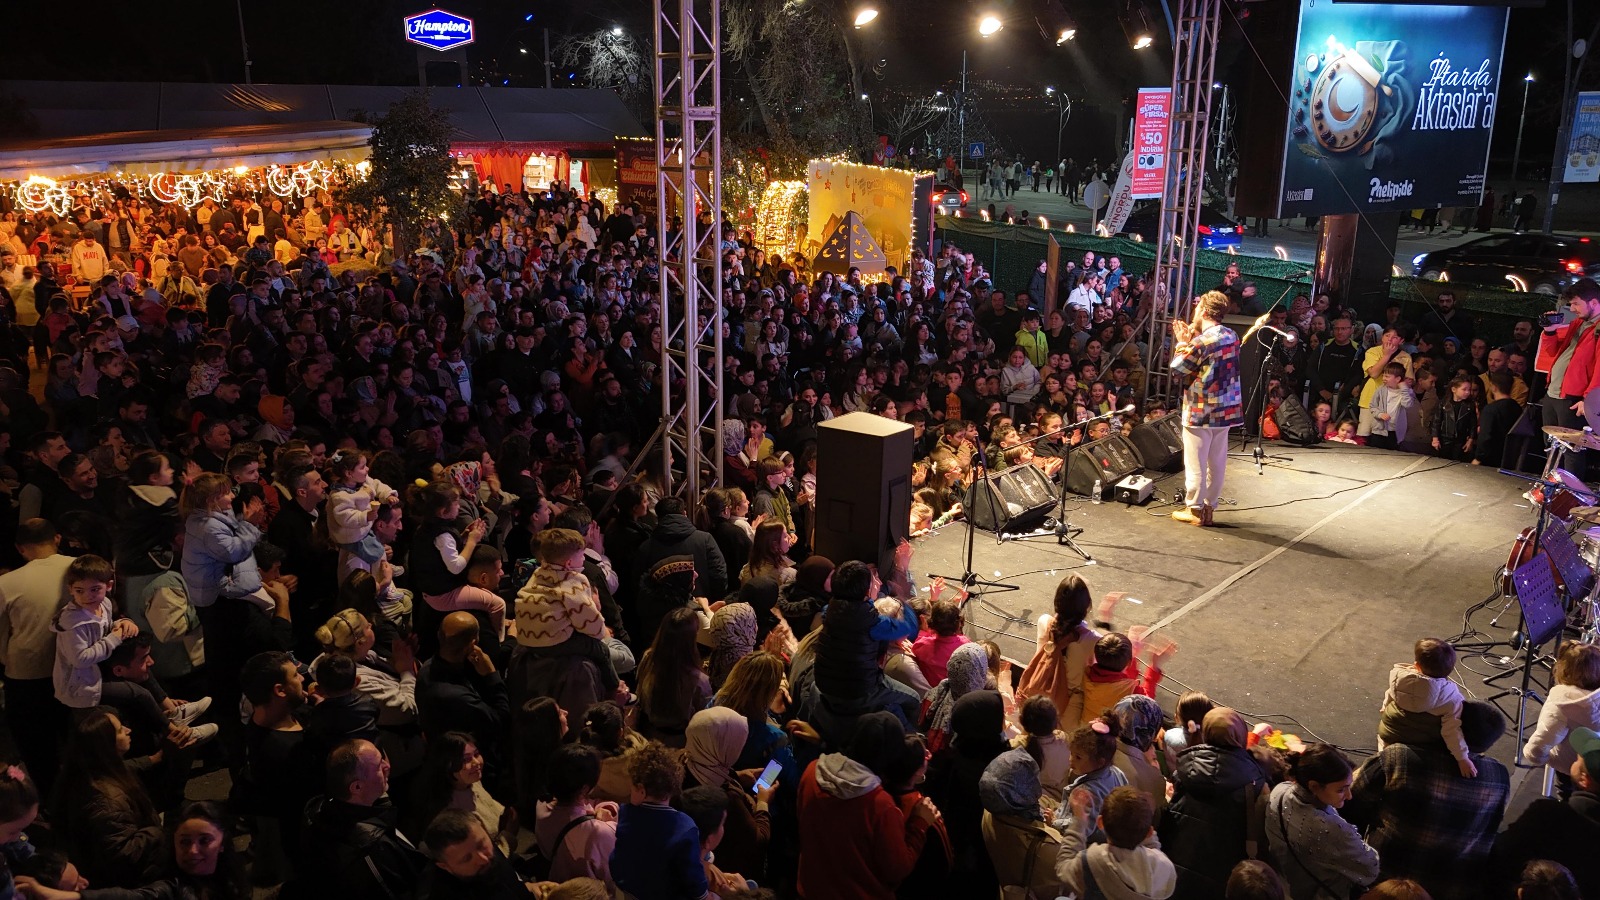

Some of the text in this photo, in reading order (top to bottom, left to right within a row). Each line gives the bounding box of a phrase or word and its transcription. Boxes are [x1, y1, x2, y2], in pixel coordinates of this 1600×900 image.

[408, 19, 471, 35] Hampton
[1423, 51, 1493, 90] İftarda
[1140, 104, 1163, 114] SÜPER
[1144, 111, 1169, 119] FIRSAT
[1140, 132, 1163, 145] %50
[1108, 184, 1131, 238] LTINORDU
